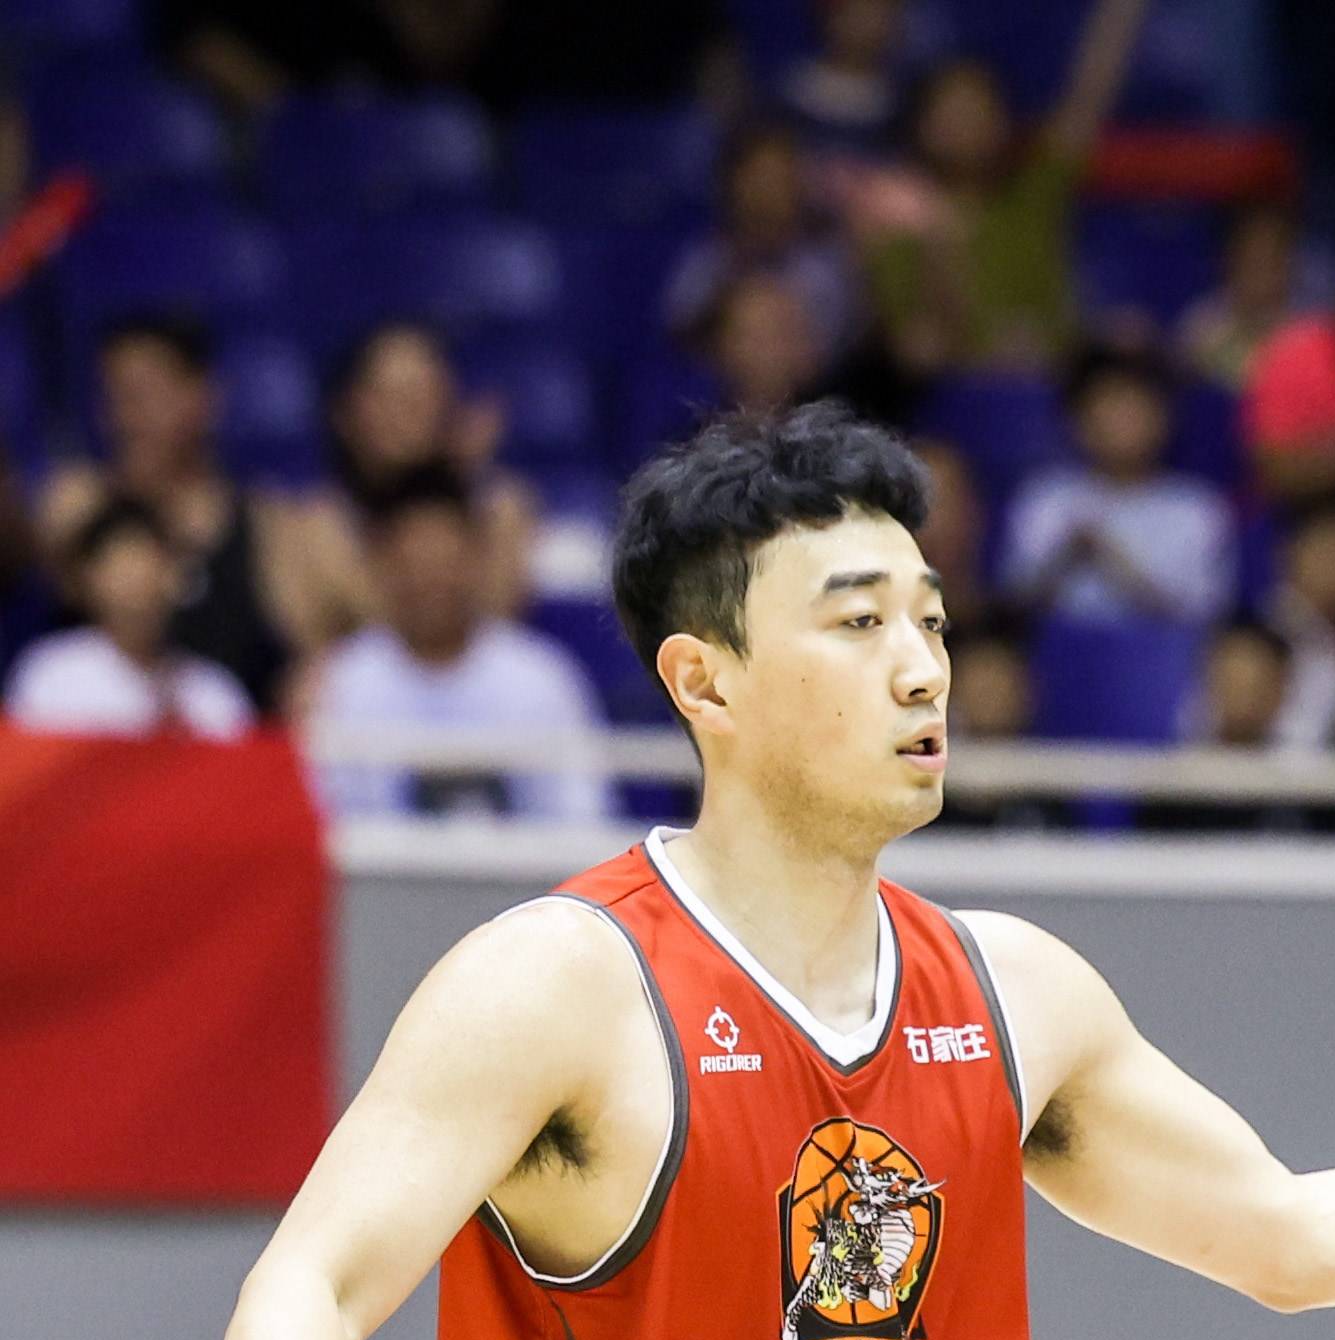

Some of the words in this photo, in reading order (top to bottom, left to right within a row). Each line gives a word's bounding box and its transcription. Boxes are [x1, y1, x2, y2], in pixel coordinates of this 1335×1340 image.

[903, 1024, 992, 1064] 石家庄
[700, 1054, 762, 1075] RIGORER
